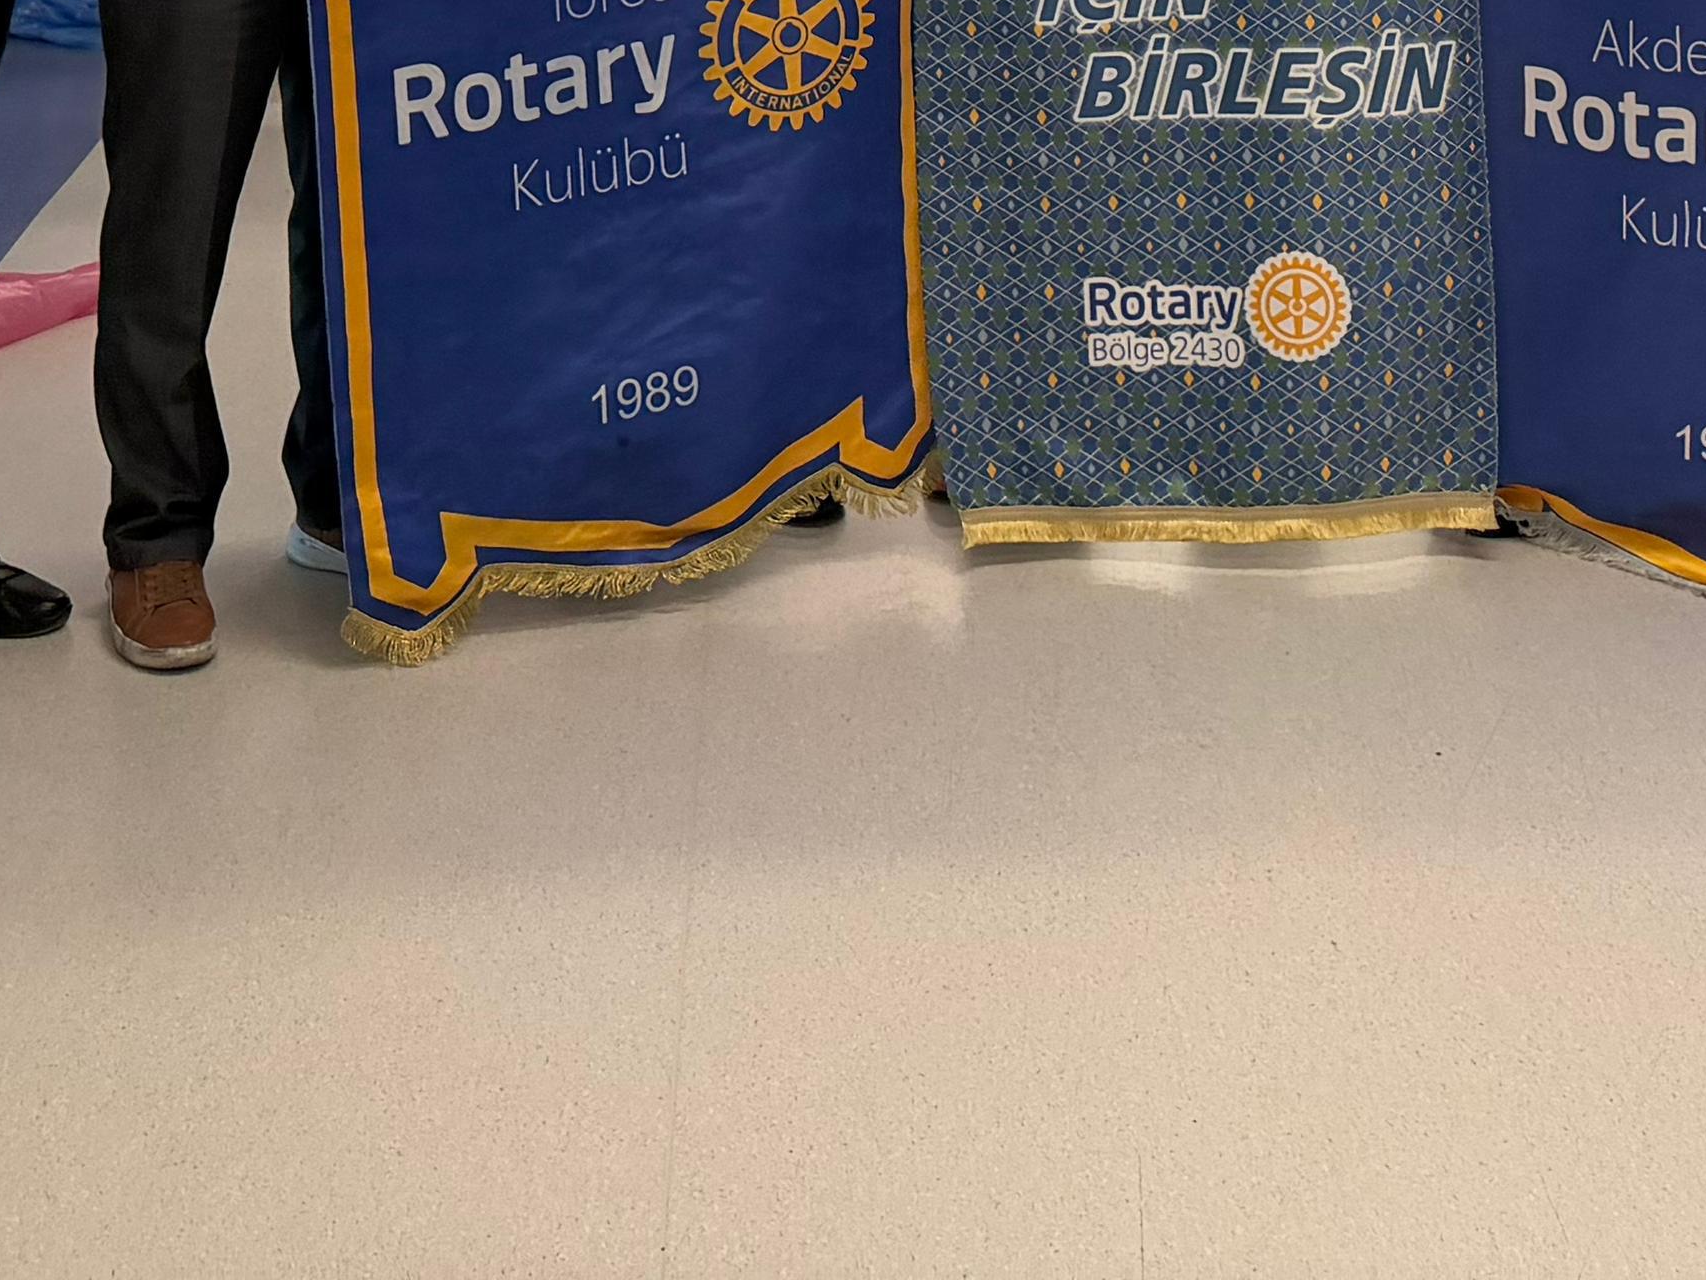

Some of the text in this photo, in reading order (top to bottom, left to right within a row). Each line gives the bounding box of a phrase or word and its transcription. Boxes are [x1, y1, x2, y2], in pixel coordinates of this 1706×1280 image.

[393, 34, 676, 145] Rotary
[732, 53, 853, 109] INTERNATIONAL
[1072, 28, 1455, 129] BİRLEŞİN
[513, 133, 688, 211] Kulübü
[1088, 282, 1238, 330] Rotary
[1093, 336, 1241, 364] Bölge 2430
[591, 366, 700, 425] 1989
